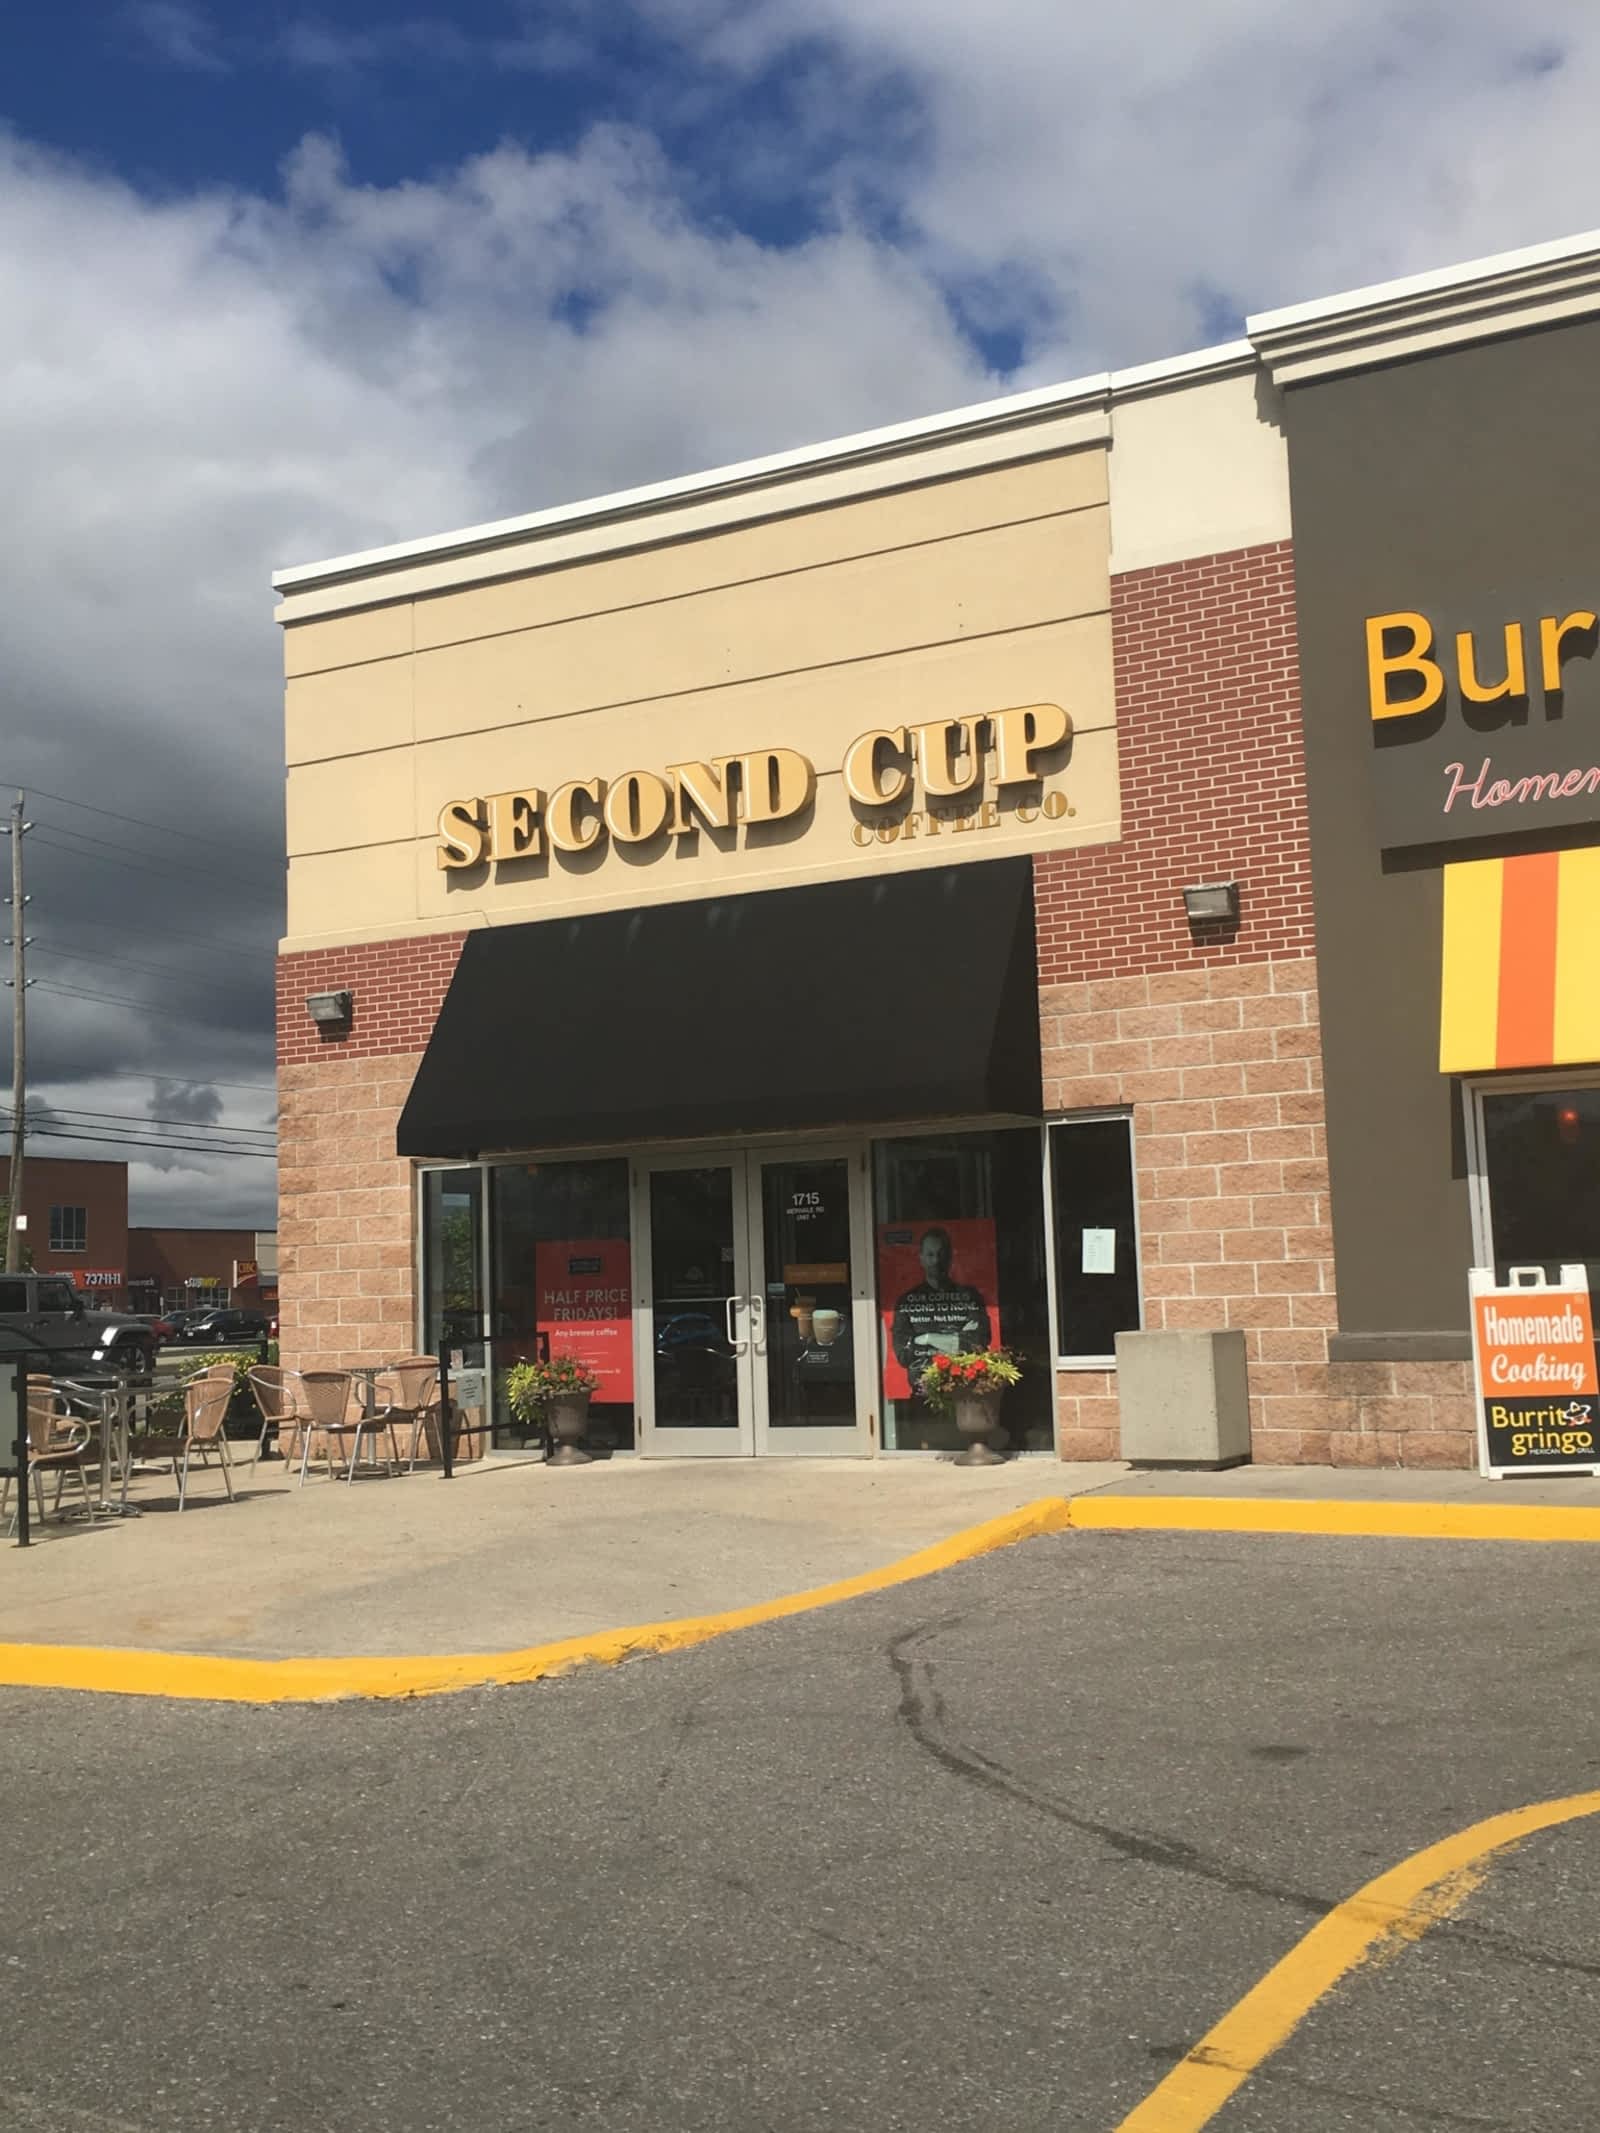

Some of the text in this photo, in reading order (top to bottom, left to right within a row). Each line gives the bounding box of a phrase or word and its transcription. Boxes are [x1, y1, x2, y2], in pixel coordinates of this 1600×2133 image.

[436, 702, 1074, 872] SECOND CUP
[850, 791, 1076, 847] COFFEE CO.
[792, 1192, 820, 1206] 1715
[544, 1288, 629, 1305] HALF PRICE
[554, 1307, 618, 1321] FRIDAYS!
[899, 1304, 935, 1313] SECOND
[937, 1303, 949, 1312] TO
[596, 1327, 618, 1337] coffee
[1484, 1304, 1584, 1346] Homemade
[1491, 1353, 1586, 1390] Cooking
[1512, 1429, 1592, 1456] gringo
